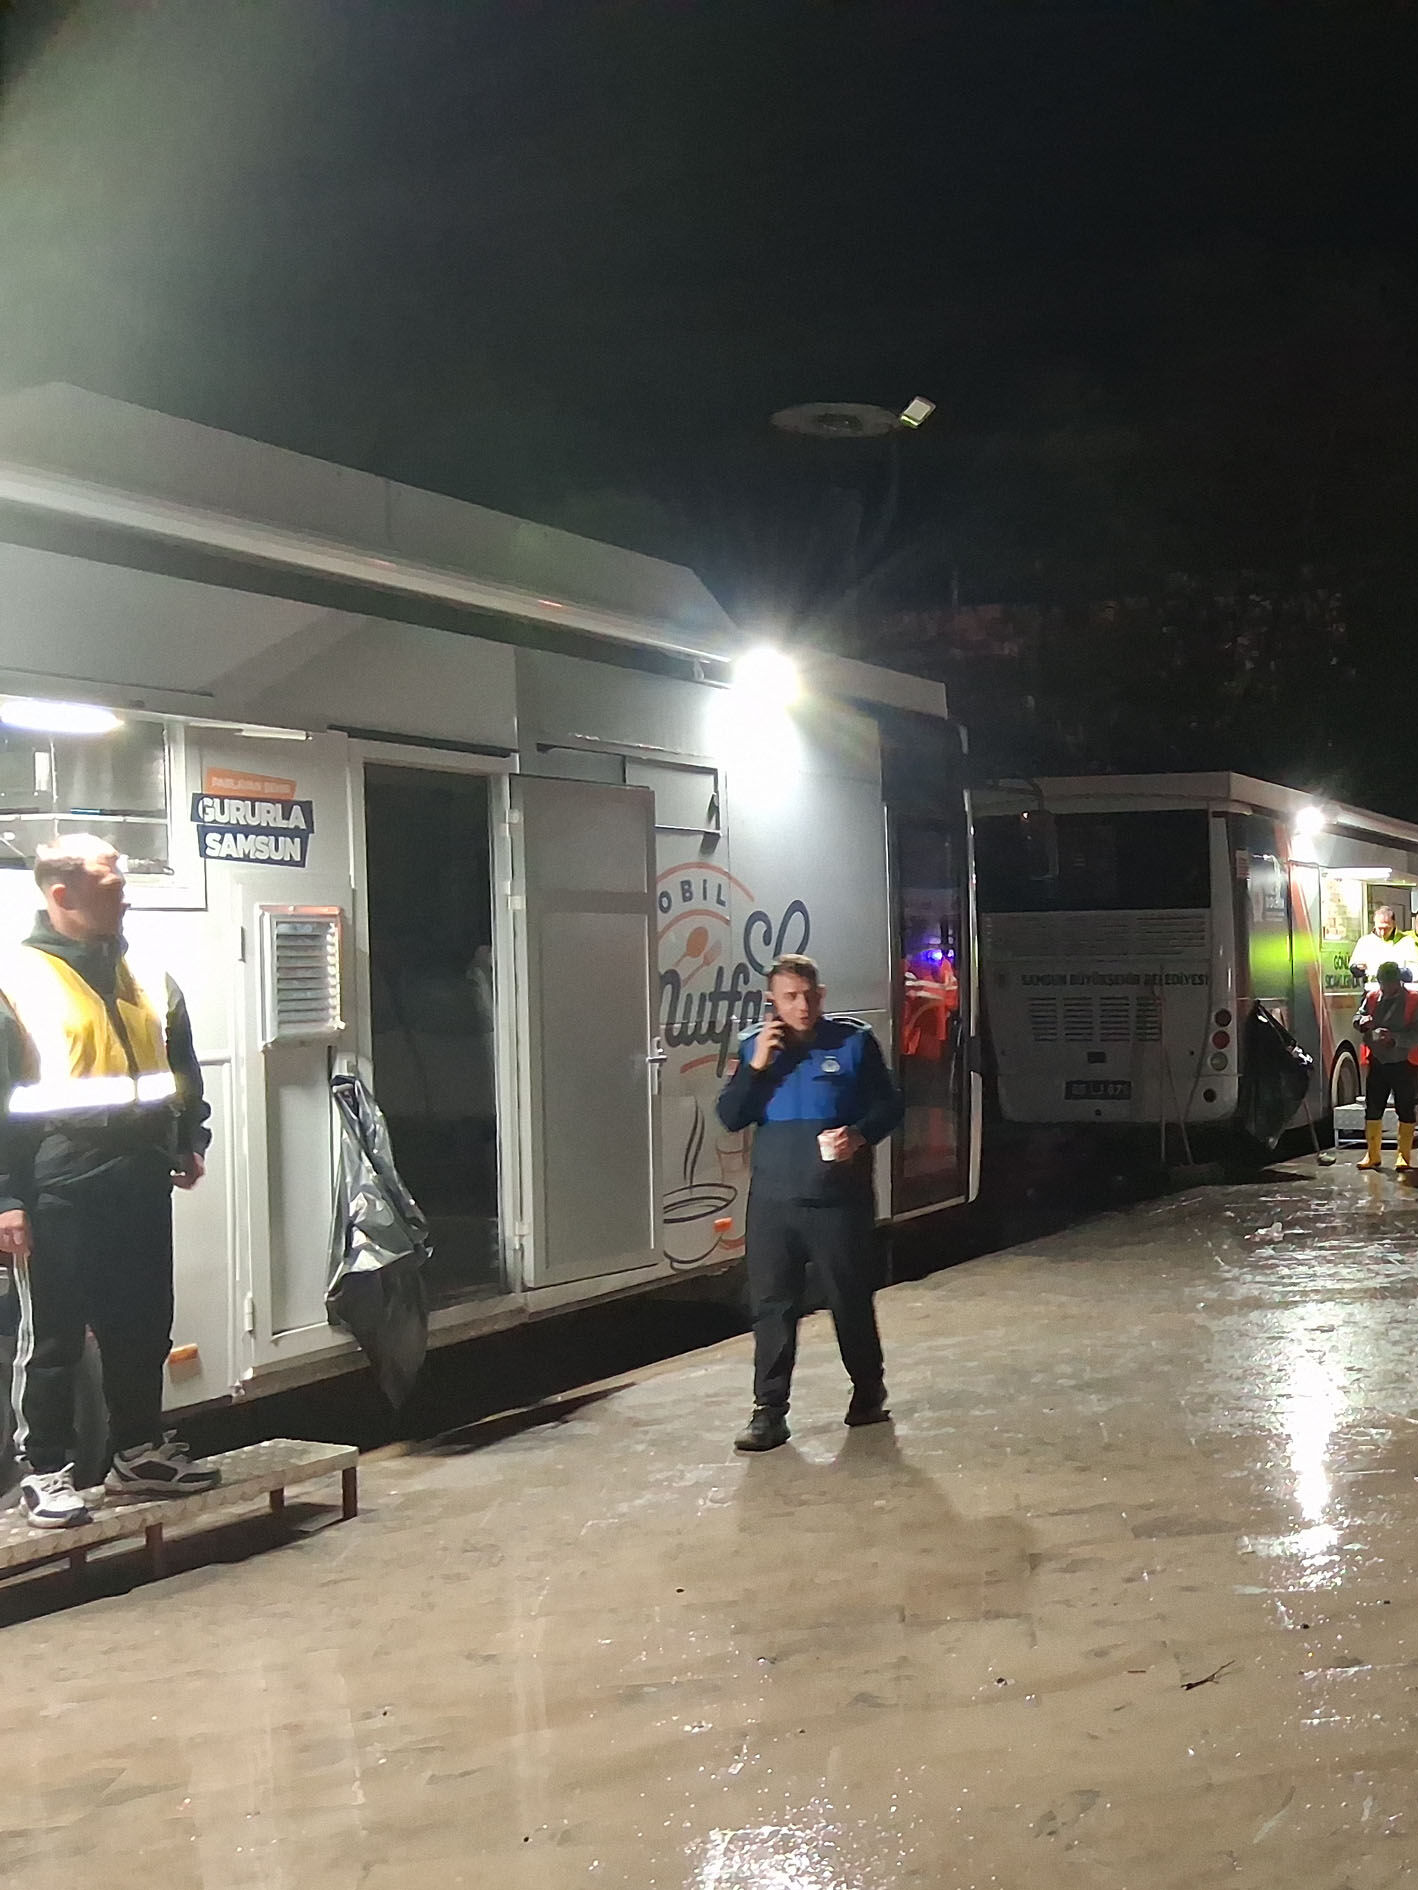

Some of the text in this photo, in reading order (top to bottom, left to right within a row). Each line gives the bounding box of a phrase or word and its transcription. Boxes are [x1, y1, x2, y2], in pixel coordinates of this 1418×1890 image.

[198, 797, 307, 829] GURURLA
[205, 832, 301, 862] SAMSUN
[658, 879, 727, 914] OBİL
